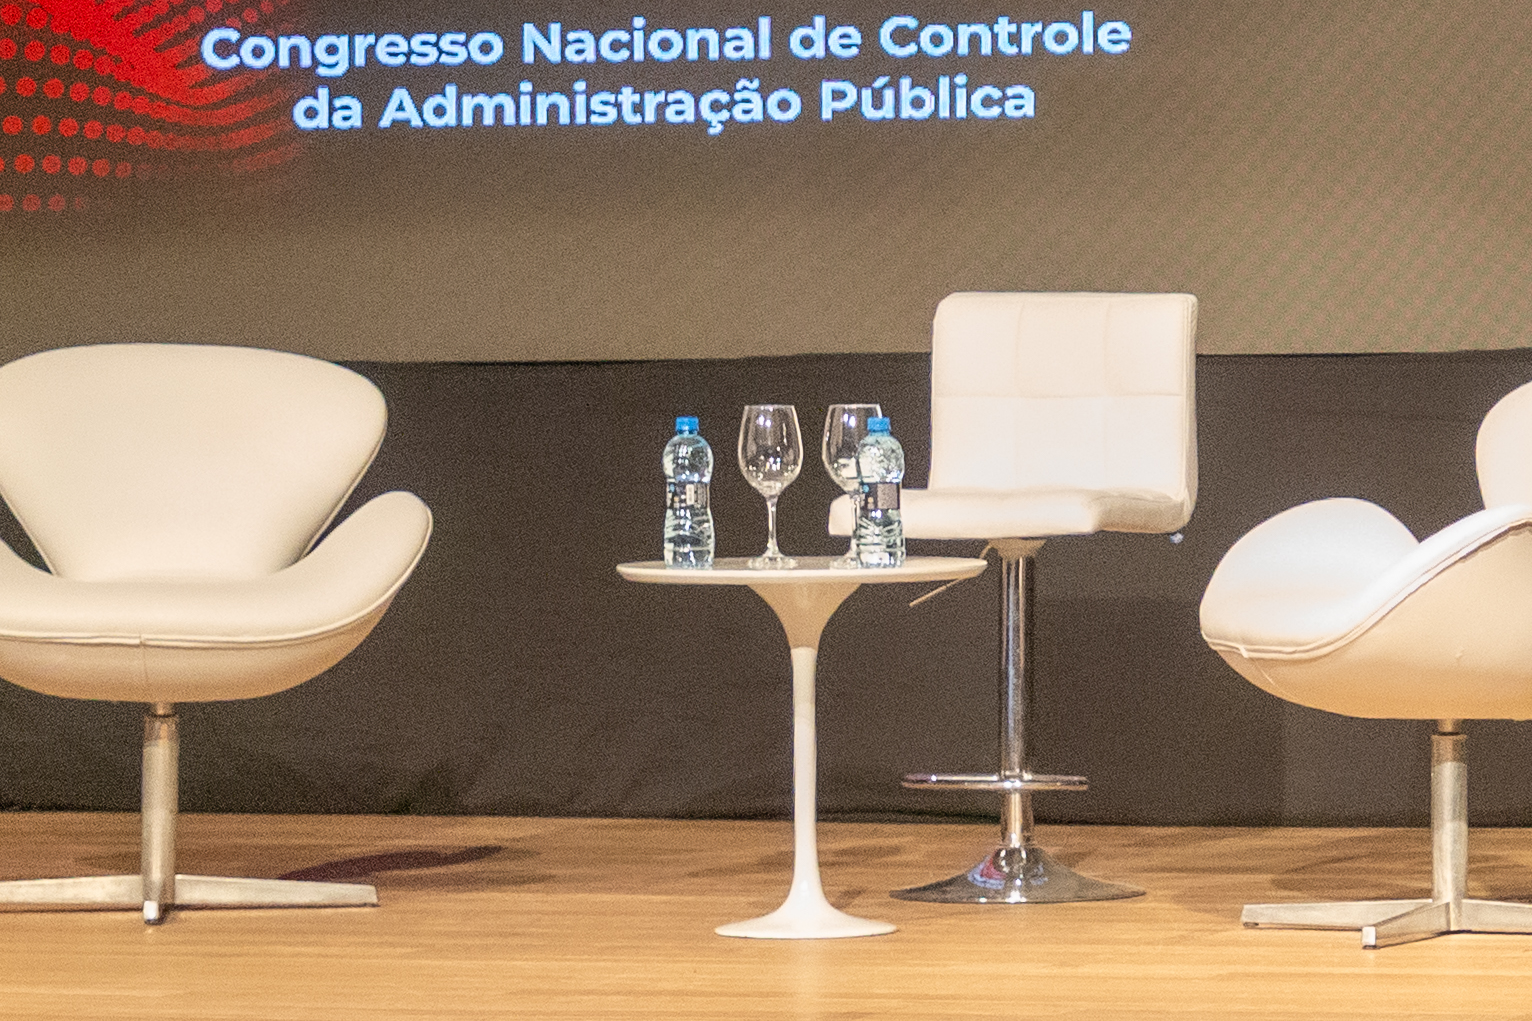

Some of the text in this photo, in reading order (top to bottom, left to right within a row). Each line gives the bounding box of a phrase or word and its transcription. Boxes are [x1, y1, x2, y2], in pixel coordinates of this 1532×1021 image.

[201, 10, 1132, 77] Congresso Nacional de Controle
[293, 73, 1035, 135] da Administração Pública
